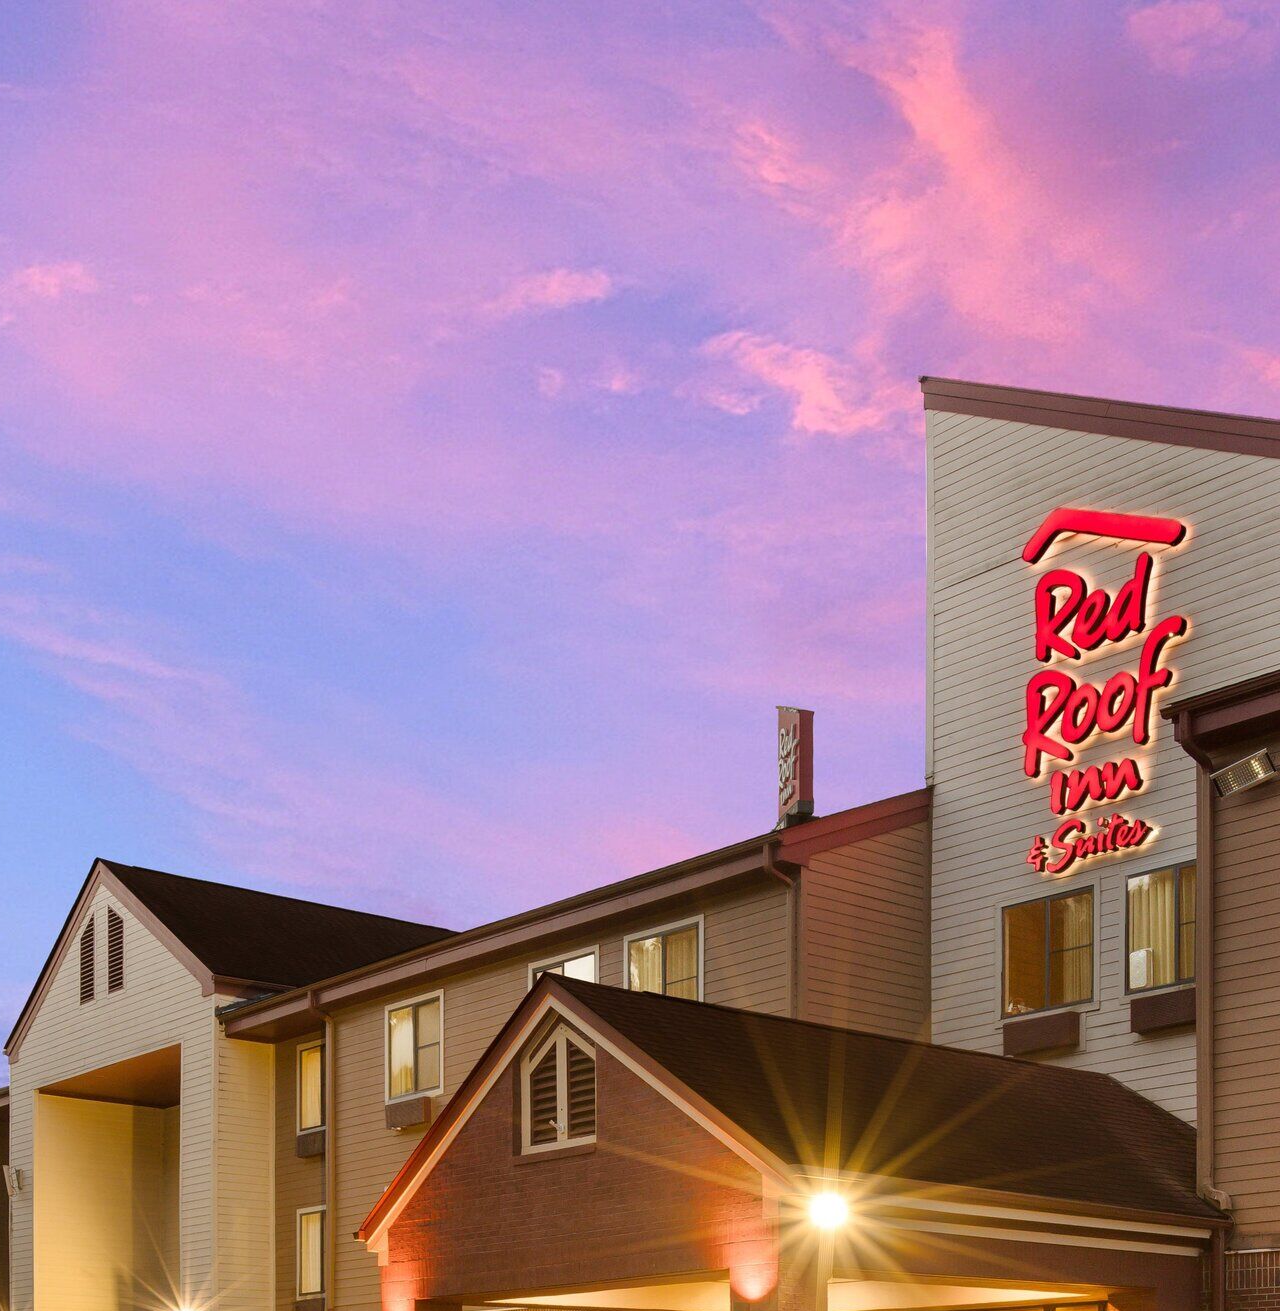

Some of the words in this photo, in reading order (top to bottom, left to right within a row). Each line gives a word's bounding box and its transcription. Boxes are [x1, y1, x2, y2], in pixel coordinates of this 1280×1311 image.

[1034, 552, 1153, 662] Red
[1022, 615, 1187, 778] Roof
[1050, 758, 1143, 815] Inn
[1026, 834, 1049, 872] &
[1047, 813, 1153, 873] Suites
